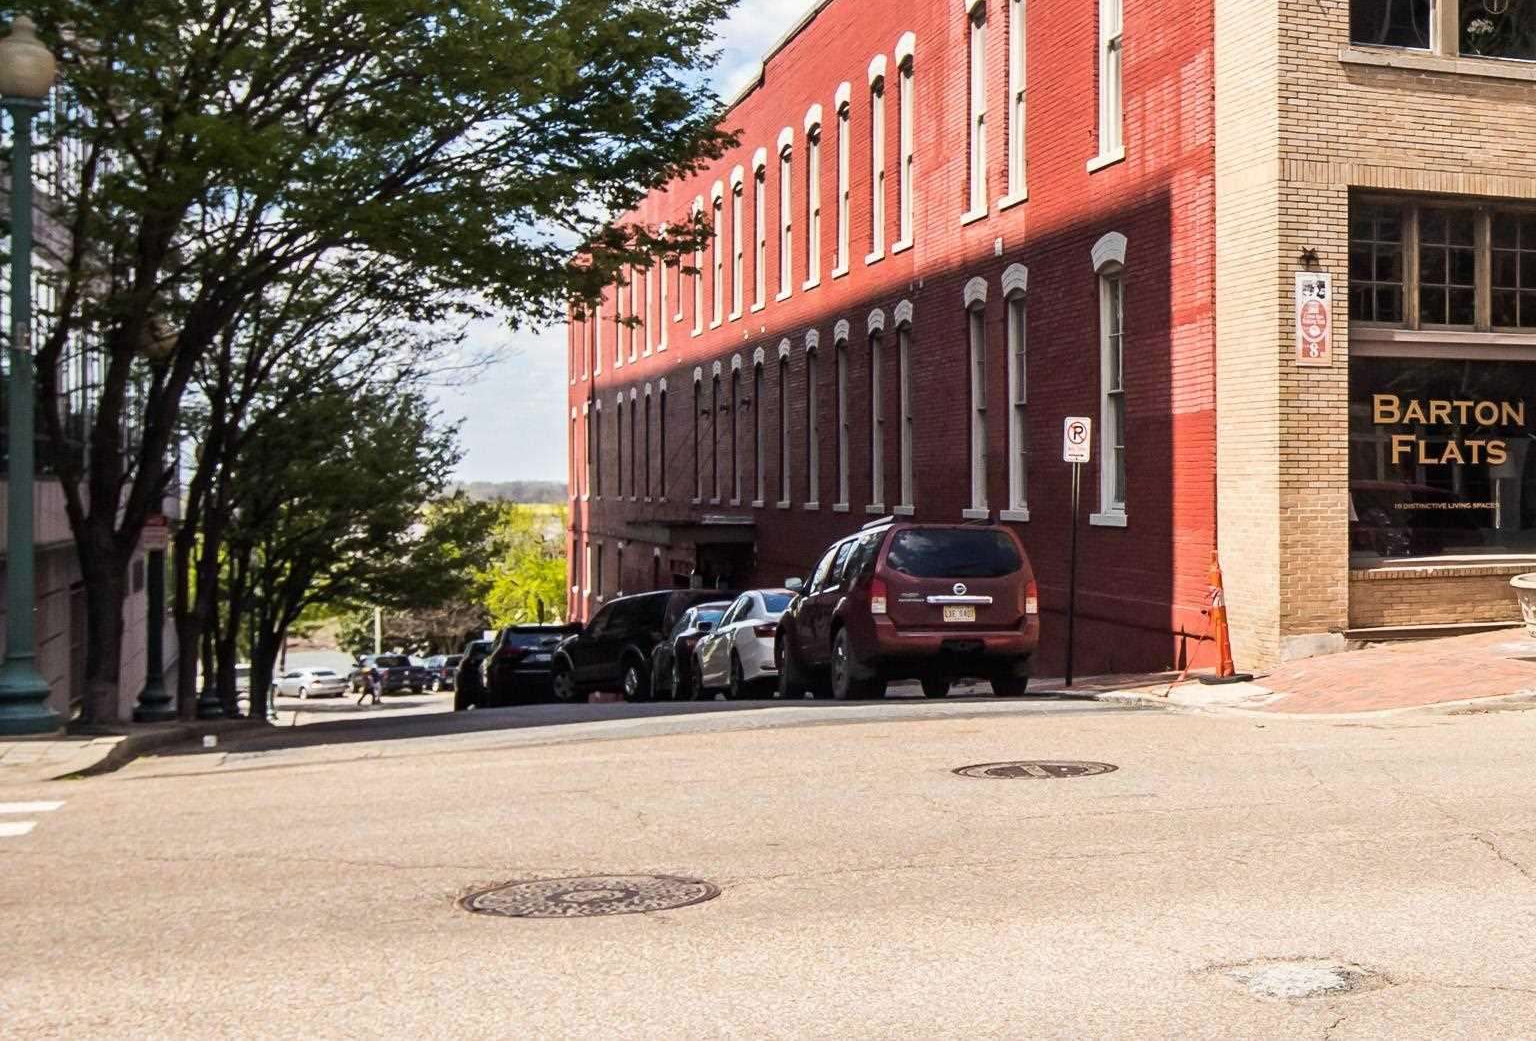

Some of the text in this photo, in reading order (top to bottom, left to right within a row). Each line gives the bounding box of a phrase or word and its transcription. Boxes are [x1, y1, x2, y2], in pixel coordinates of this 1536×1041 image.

[1372, 393, 1525, 426] BARTON
[1391, 434, 1507, 465] FLATS
[1448, 502, 1471, 510] LIVING
